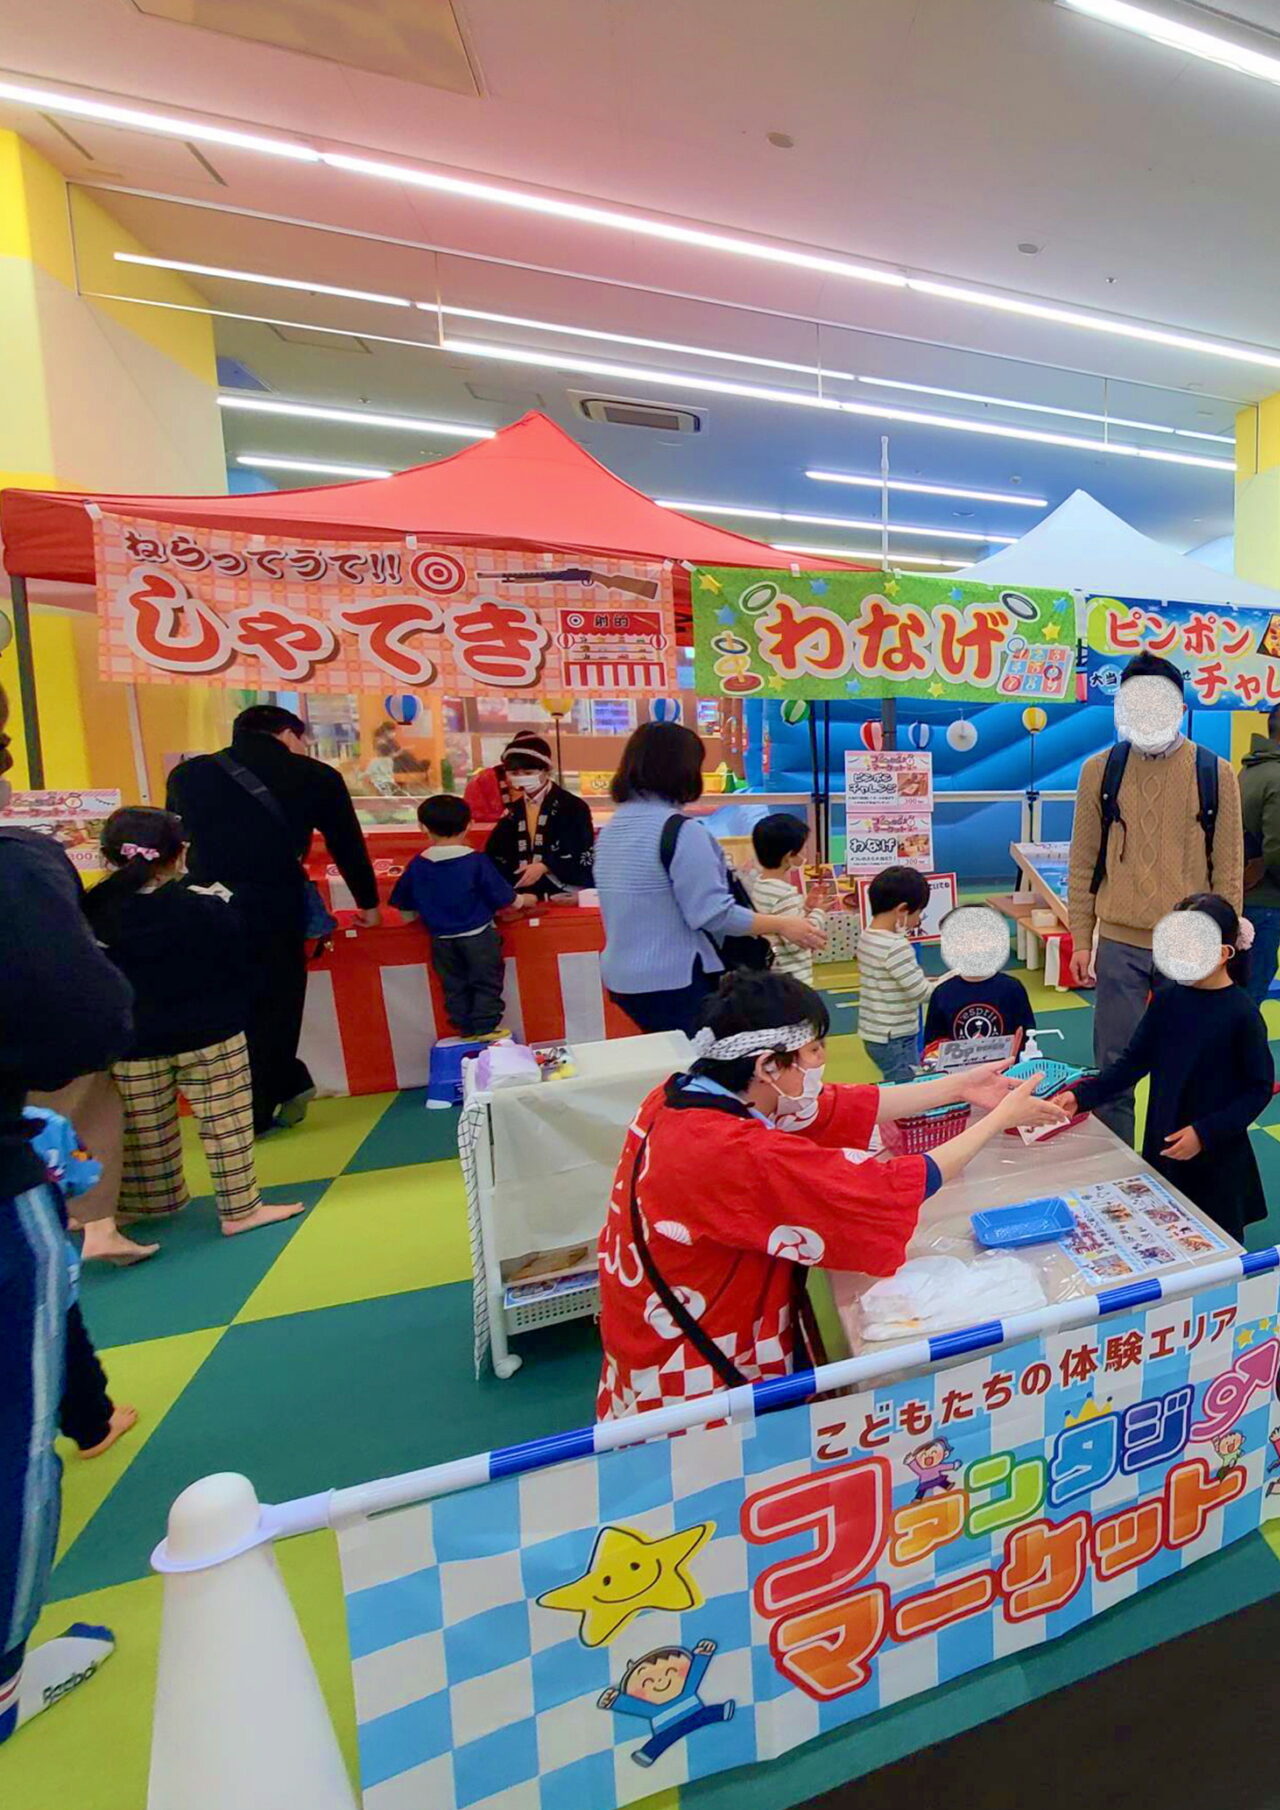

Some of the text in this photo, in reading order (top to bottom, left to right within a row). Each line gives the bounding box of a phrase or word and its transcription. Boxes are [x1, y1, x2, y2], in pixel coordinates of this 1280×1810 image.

[122, 566, 552, 688] しゃてき
[758, 592, 1012, 688] わなげ
[1107, 609, 1252, 656] ピンポン
[849, 838, 897, 853] わなげ
[815, 1304, 1238, 1461] こどもたちの体験エリア
[769, 1457, 1248, 1702] マーケット
